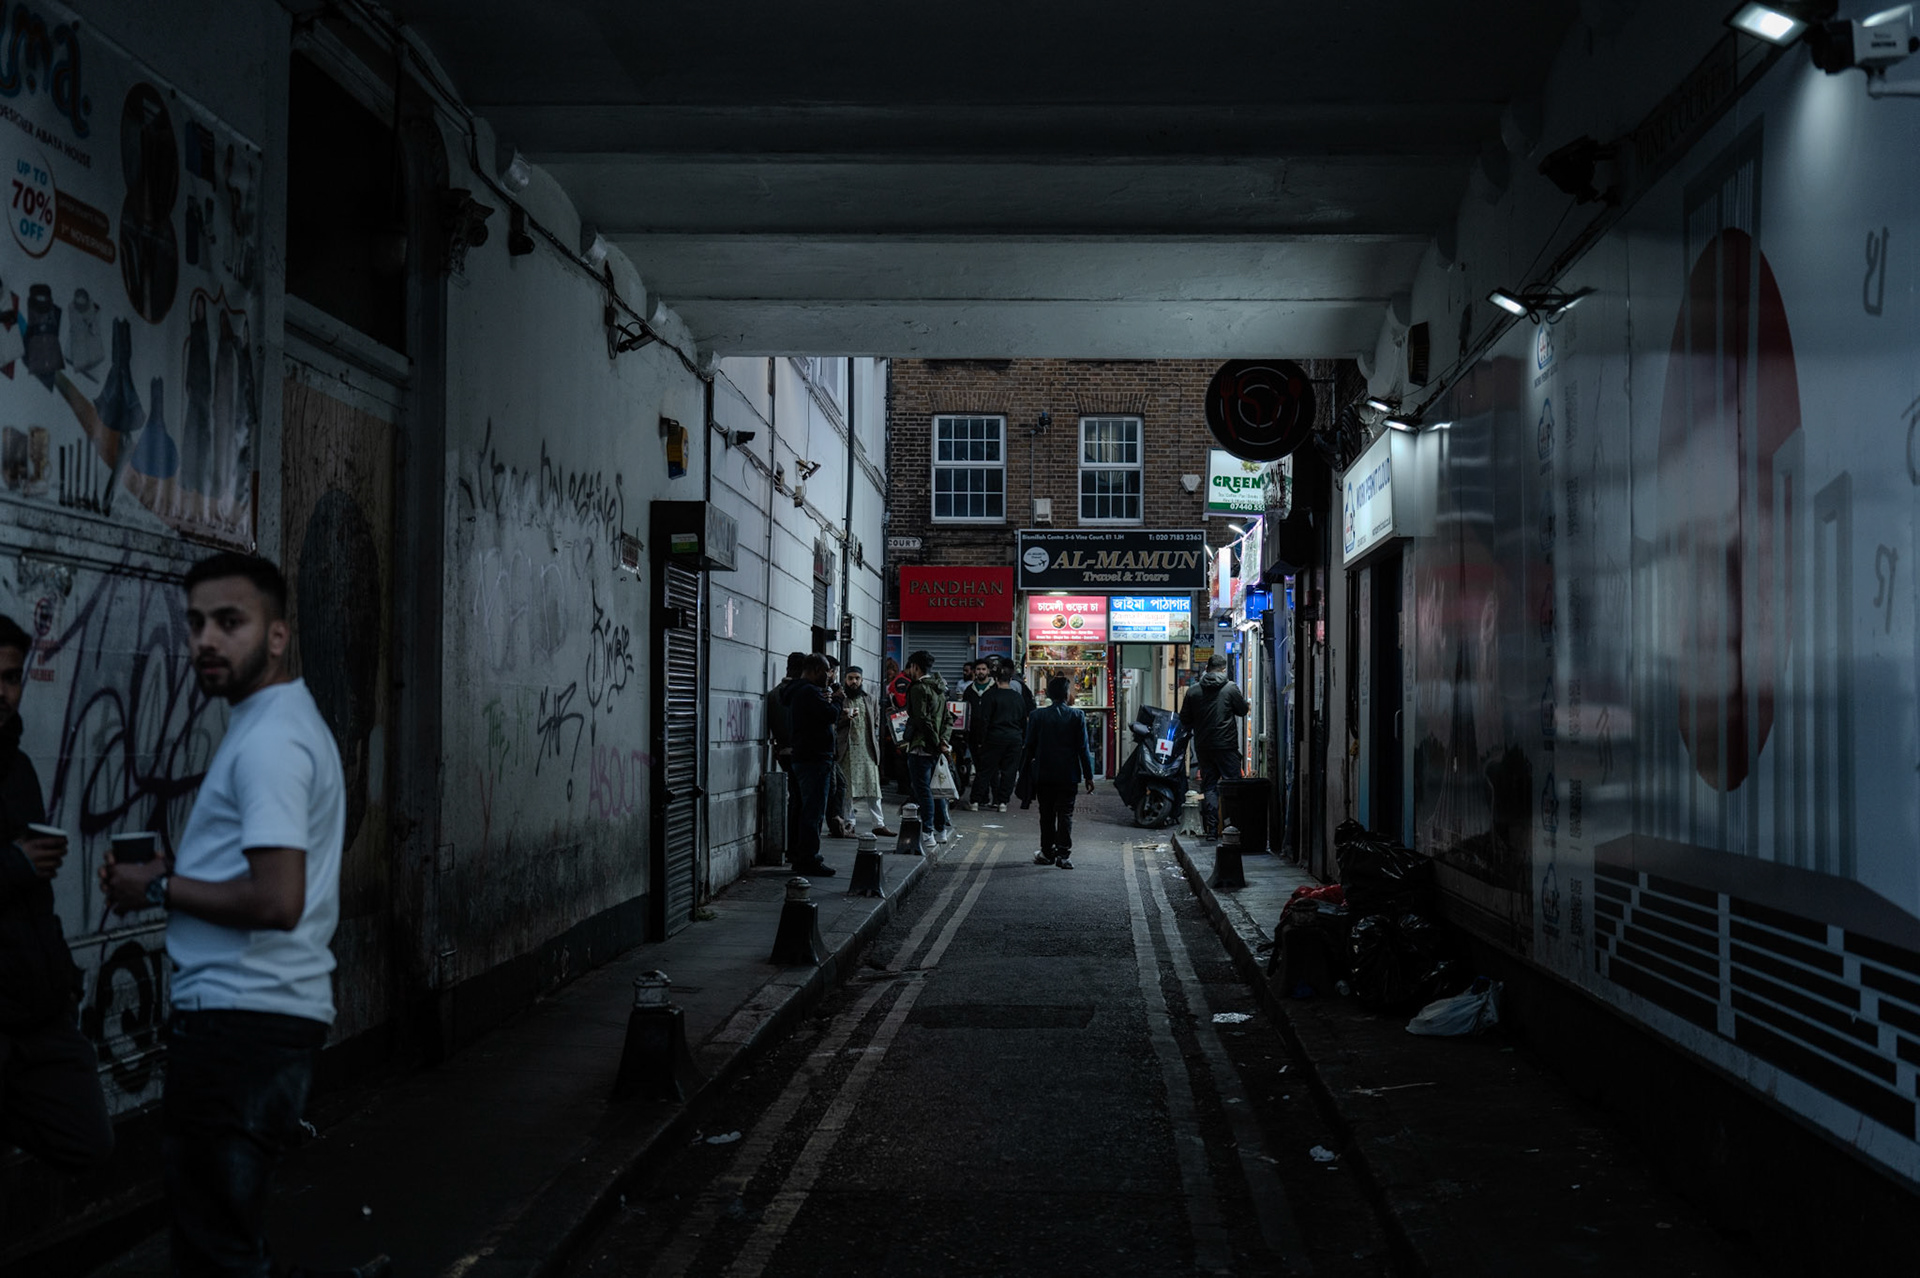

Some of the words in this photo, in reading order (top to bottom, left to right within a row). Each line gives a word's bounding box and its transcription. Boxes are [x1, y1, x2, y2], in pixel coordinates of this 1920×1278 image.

[64, 144, 92, 169] HOUSE
[17, 159, 31, 175] UP
[33, 167, 48, 186] TO
[12, 179, 53, 226] 70%
[20, 217, 45, 243] OFF
[888, 539, 917, 547] COURT
[1051, 551, 1201, 569] AL-MAMUN
[1083, 571, 1123, 582] Travel
[1123, 572, 1134, 582] &
[1135, 571, 1170, 582] Tours
[909, 580, 1004, 595] PANDHAN
[929, 597, 985, 608] KITCHEN
[1113, 597, 1144, 610] জাইমা
[1150, 597, 1190, 610] পাঠাগার
[953, 703, 961, 713] L
[1160, 742, 1168, 751] L
